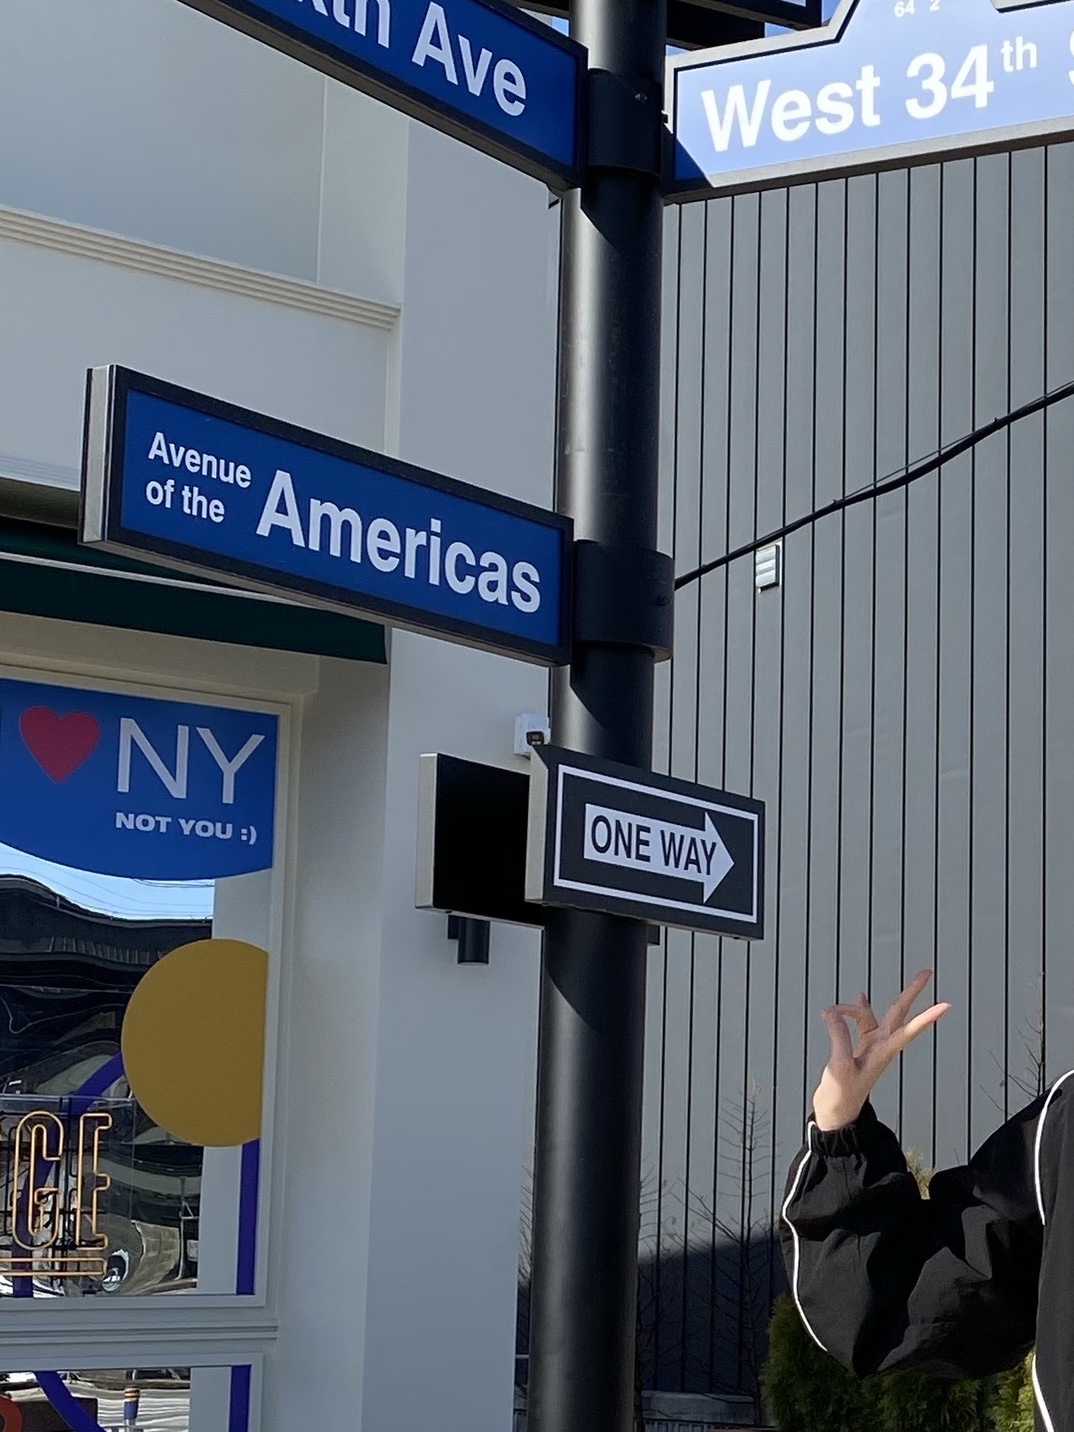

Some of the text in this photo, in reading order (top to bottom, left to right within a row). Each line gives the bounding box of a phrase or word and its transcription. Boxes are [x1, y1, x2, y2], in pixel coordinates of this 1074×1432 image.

[412, 1, 527, 117] Ave
[701, 64, 882, 152] West
[905, 35, 1038, 120] 34th
[148, 432, 252, 488] Avenue
[146, 479, 225, 523] of the
[255, 470, 541, 613] Americas
[117, 717, 266, 804] NY
[115, 812, 172, 834] NOT
[178, 818, 233, 840] YOU
[591, 814, 717, 876] ONE WAY
